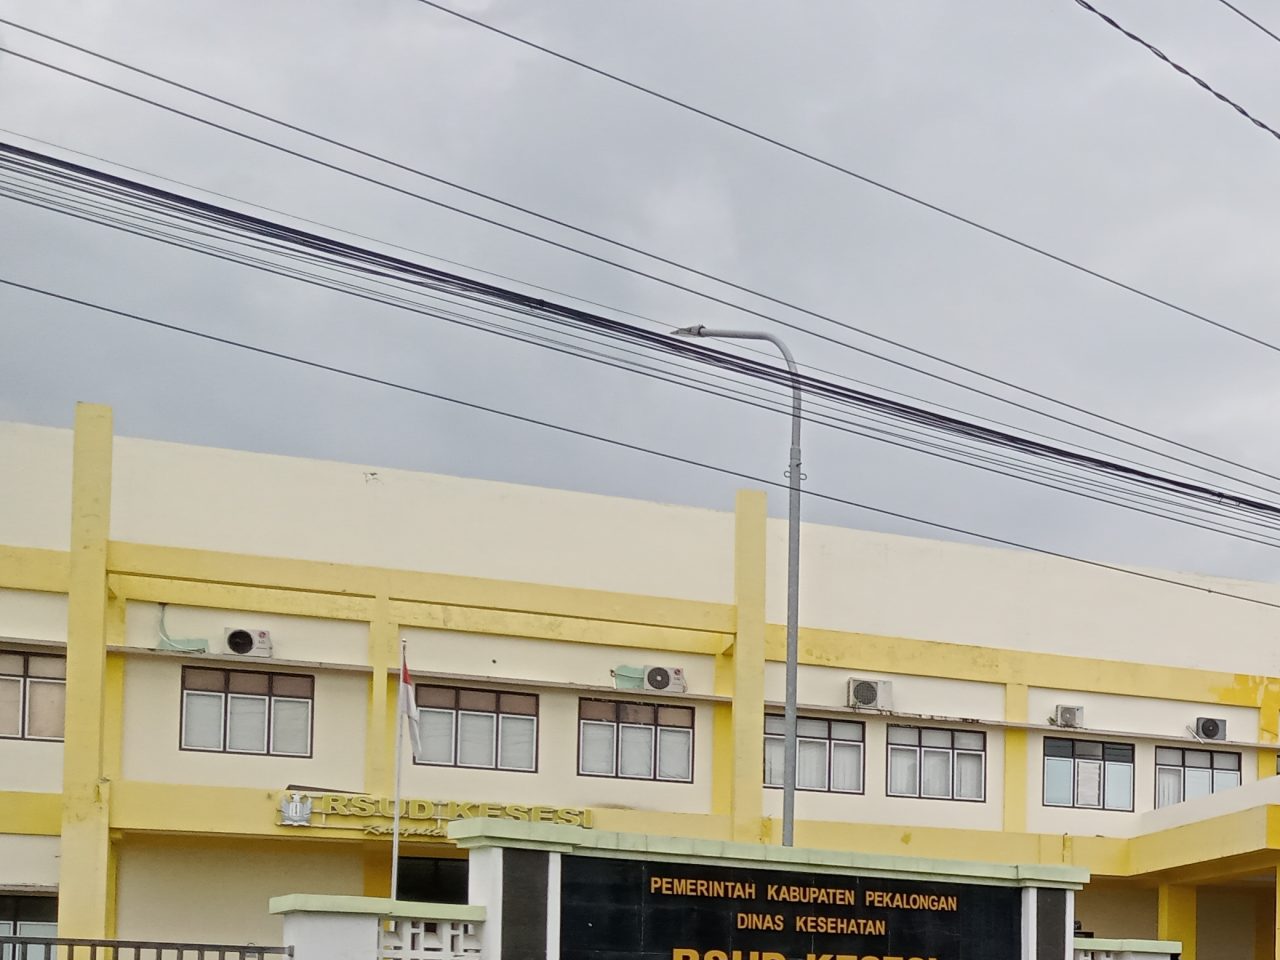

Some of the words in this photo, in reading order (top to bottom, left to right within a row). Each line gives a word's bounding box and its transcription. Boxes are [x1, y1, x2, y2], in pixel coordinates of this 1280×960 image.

[321, 795, 434, 820] RSUD
[448, 801, 593, 829] KESESI
[651, 877, 756, 899] PEMERINTAH
[767, 884, 855, 906] KABUPATEN
[865, 891, 957, 911] PEKALONGAN
[737, 913, 784, 931] DINAS
[796, 916, 886, 935] KESEHATAN
